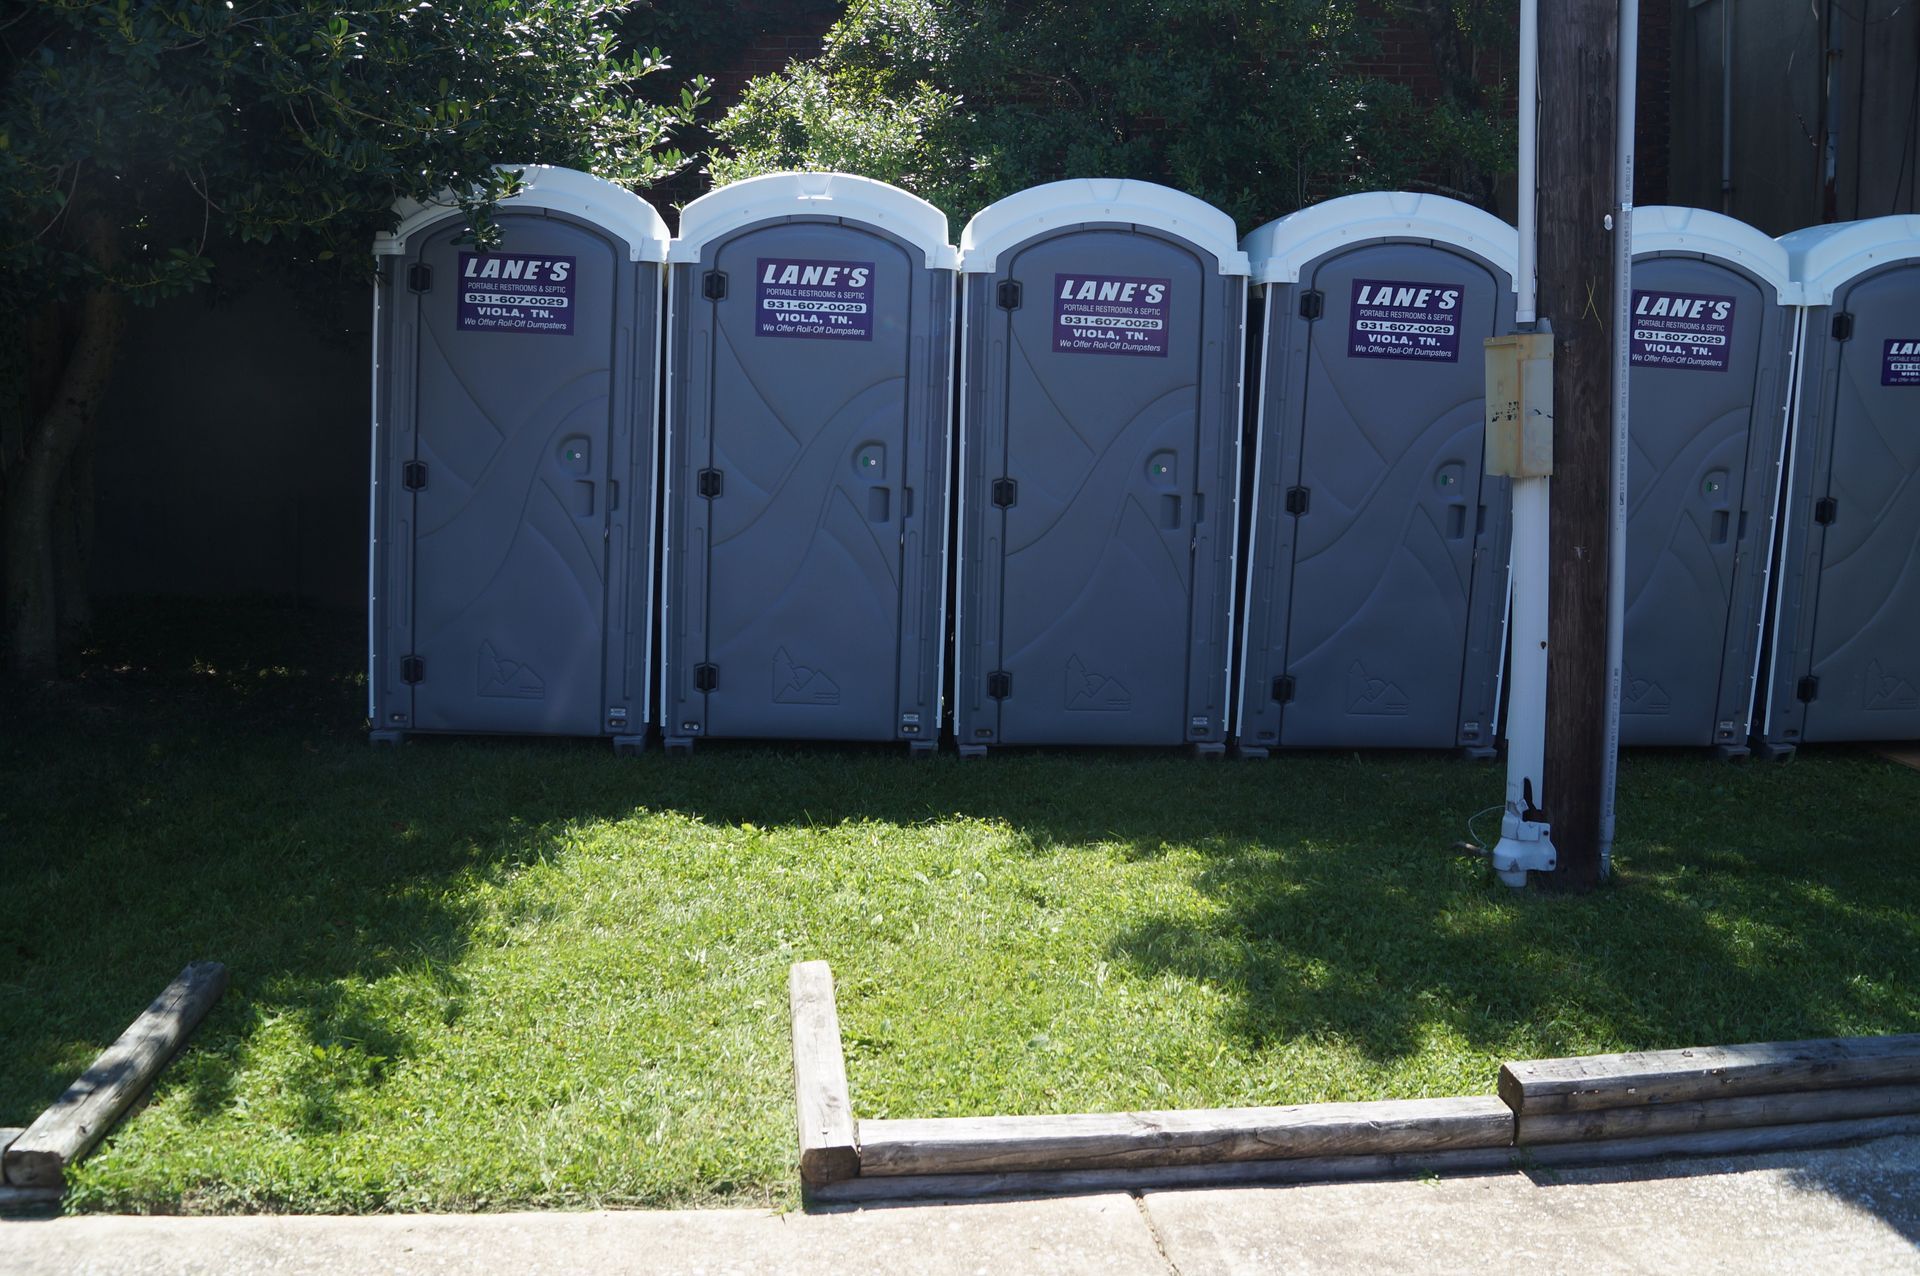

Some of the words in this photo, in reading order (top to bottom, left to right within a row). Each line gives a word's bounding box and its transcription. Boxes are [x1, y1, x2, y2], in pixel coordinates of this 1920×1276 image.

[464, 258, 570, 281] LANE'S
[763, 264, 869, 287] LANE'S
[468, 282, 498, 290] PORTABLE
[500, 284, 537, 292] RESTROOMS
[1060, 280, 1166, 304] LANE'S
[767, 288, 797, 296] PORTABLE
[798, 290, 836, 298] RESTROOMS
[844, 292, 865, 300] SEPTIC
[1357, 286, 1459, 310] LANE'S
[469, 295, 564, 306] 931-607-0029
[767, 301, 863, 312] 931-607-0029
[477, 307, 524, 318] VIOLA,
[531, 310, 554, 318] TN.
[1064, 304, 1094, 312] PORTABLE
[1096, 305, 1133, 314] RESTROOMS
[1636, 296, 1731, 320] LANE'S
[776, 313, 823, 324] VIOLA,
[829, 316, 852, 324] TN.
[1360, 310, 1389, 318] PORTABLE
[1391, 311, 1426, 320] RESTROOMS
[478, 318, 496, 326] Offer
[498, 320, 526, 328] Roll-Off
[527, 321, 566, 330] Dumpsters
[1065, 317, 1159, 328] 931-607-0029
[1361, 322, 1451, 334] 931-607-0029
[1638, 320, 1665, 328] PORTABLE
[1666, 321, 1700, 330] RESTROOMS
[1706, 324, 1725, 332] SEPTIC
[776, 324, 795, 332] Offer
[796, 325, 824, 333] Roll-Off
[826, 326, 865, 336] Dumpsters
[1073, 329, 1120, 340] VIOLA,
[1126, 332, 1148, 341] TN.
[1368, 334, 1413, 345] VIOLA,
[1419, 337, 1440, 346] TN.
[1638, 332, 1722, 344] 931-607-0029
[1073, 340, 1091, 348] Offer
[1093, 341, 1121, 349] Roll-Off
[1122, 342, 1160, 352] Dumpsters
[1368, 345, 1386, 354] Offer
[1387, 346, 1414, 355] Roll-Off
[1415, 348, 1451, 357] Dumpsters
[1645, 343, 1686, 355] VIOLA,
[1692, 347, 1712, 356] TN.
[1644, 354, 1660, 362] Offer
[1662, 356, 1686, 364] Roll-Off
[1687, 357, 1722, 367] Dumpsters
